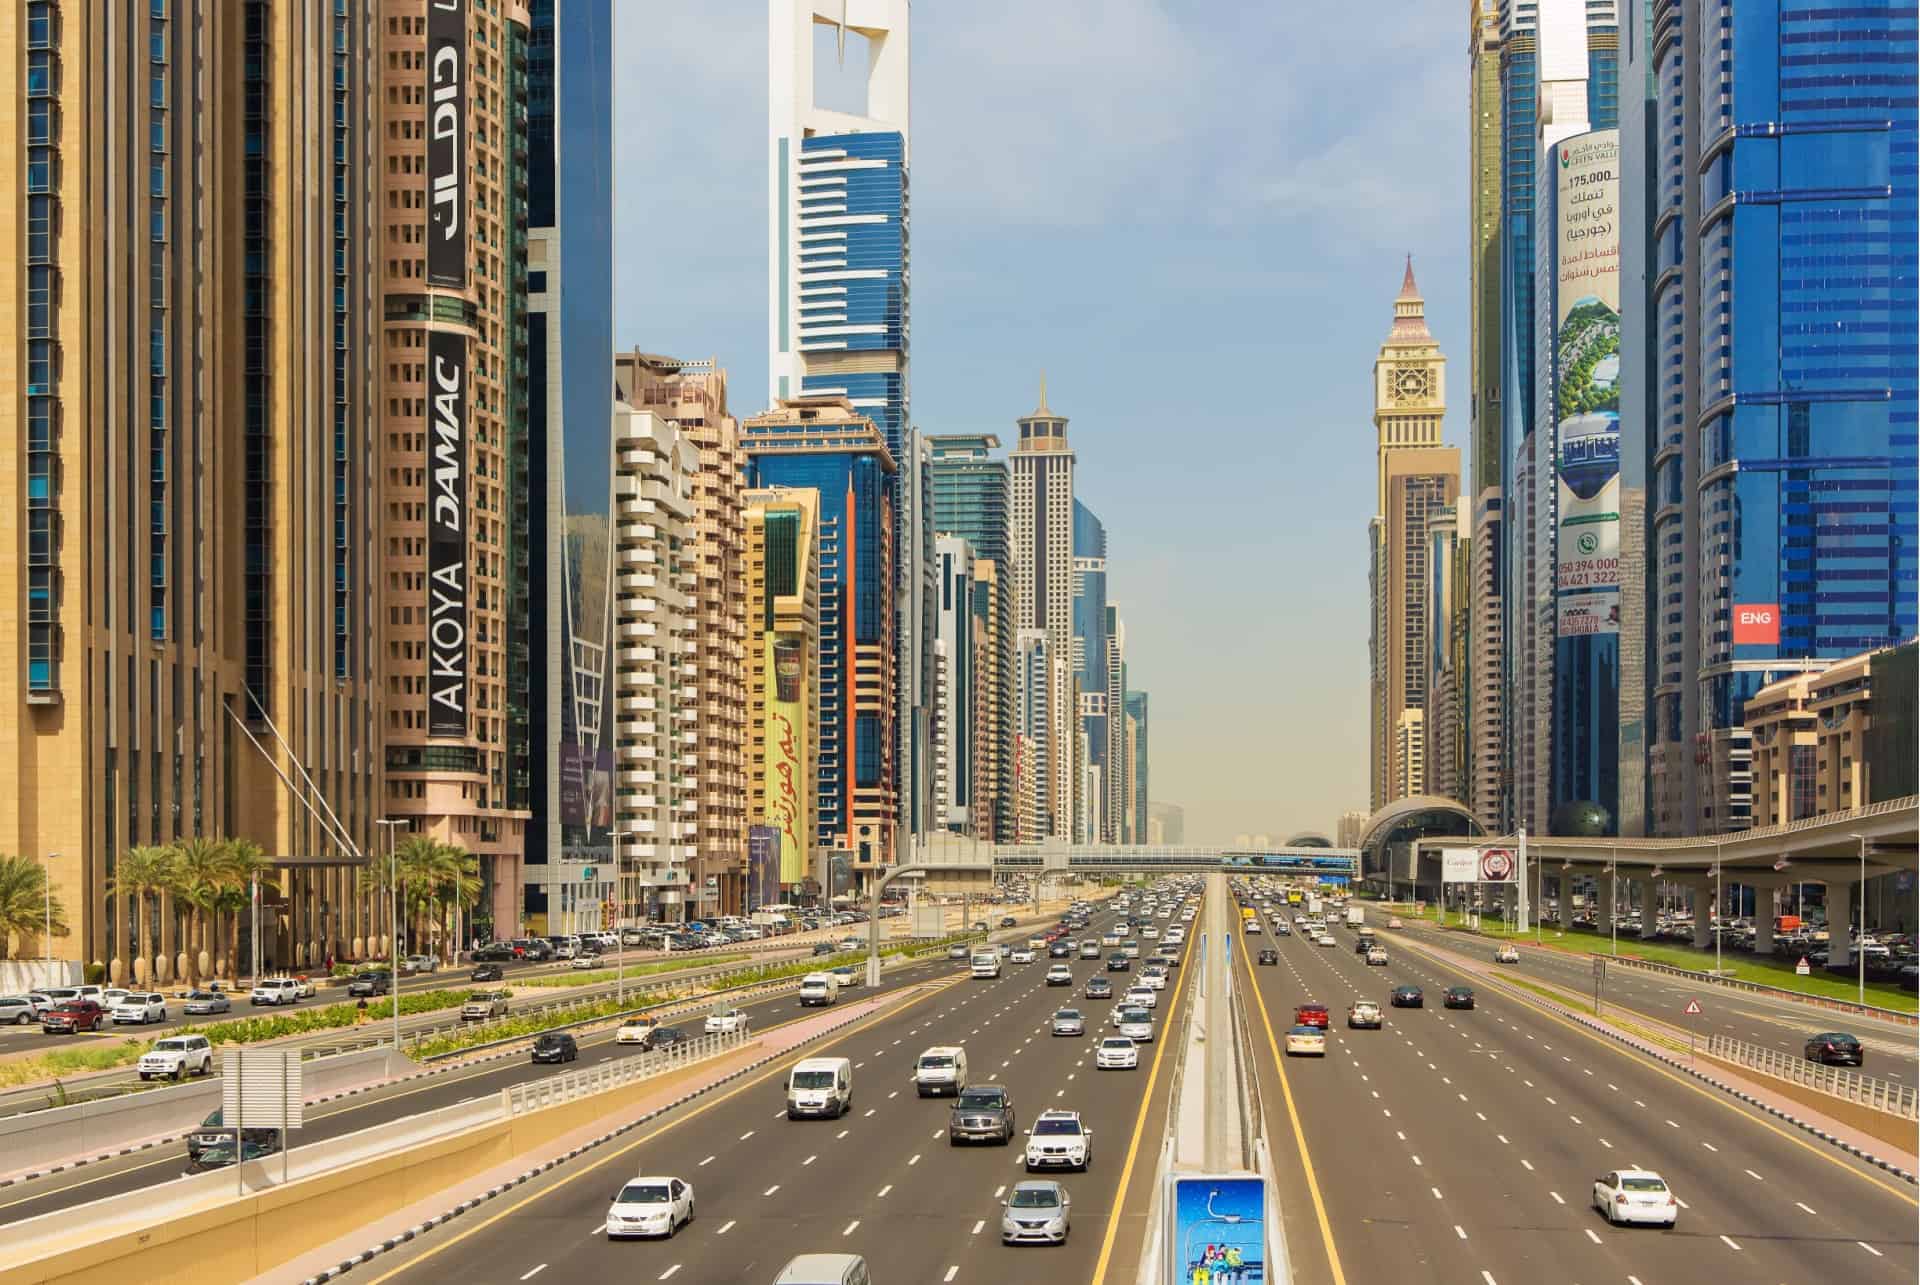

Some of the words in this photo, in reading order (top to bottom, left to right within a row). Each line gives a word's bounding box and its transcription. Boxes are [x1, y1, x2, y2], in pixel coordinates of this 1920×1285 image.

[1592, 204, 1613, 221] في
[435, 356, 460, 532] DAMAC
[1593, 571, 1619, 583] 322
[1741, 612, 1771, 625] ENG
[431, 562, 464, 712] AKOYA
